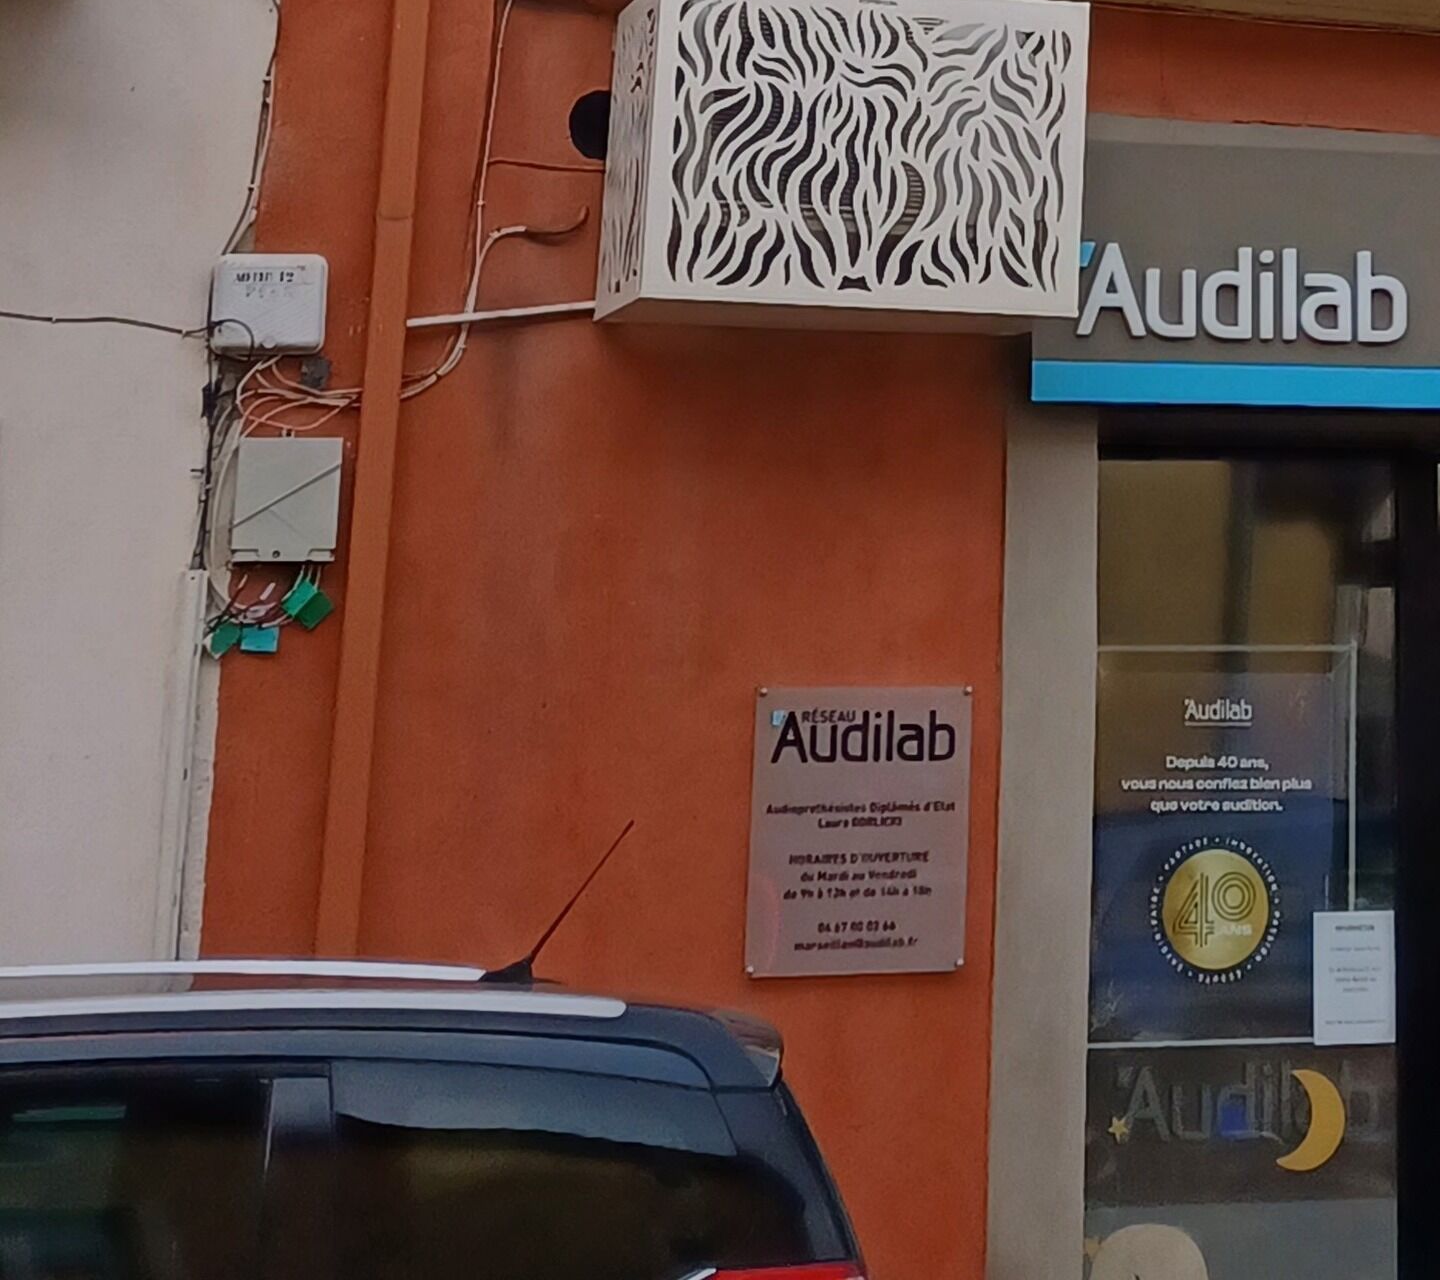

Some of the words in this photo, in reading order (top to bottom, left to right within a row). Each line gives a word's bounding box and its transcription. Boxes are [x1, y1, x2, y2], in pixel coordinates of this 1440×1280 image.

[1075, 241, 1408, 343] Audilab
[801, 707, 856, 724] RÉSEAU
[1184, 698, 1253, 721] Audilab
[770, 709, 956, 764] Audilab
[1166, 755, 1215, 771] Depuis
[1217, 755, 1238, 769] 40
[1239, 757, 1269, 771] ans,
[1121, 778, 1157, 790] vous
[1158, 778, 1194, 790] nous
[1195, 777, 1249, 790] confiez
[1250, 777, 1281, 790] bien
[1281, 777, 1313, 792] plus
[1150, 799, 1178, 814] que
[1180, 799, 1221, 812] votre
[1172, 871, 1256, 948] 40
